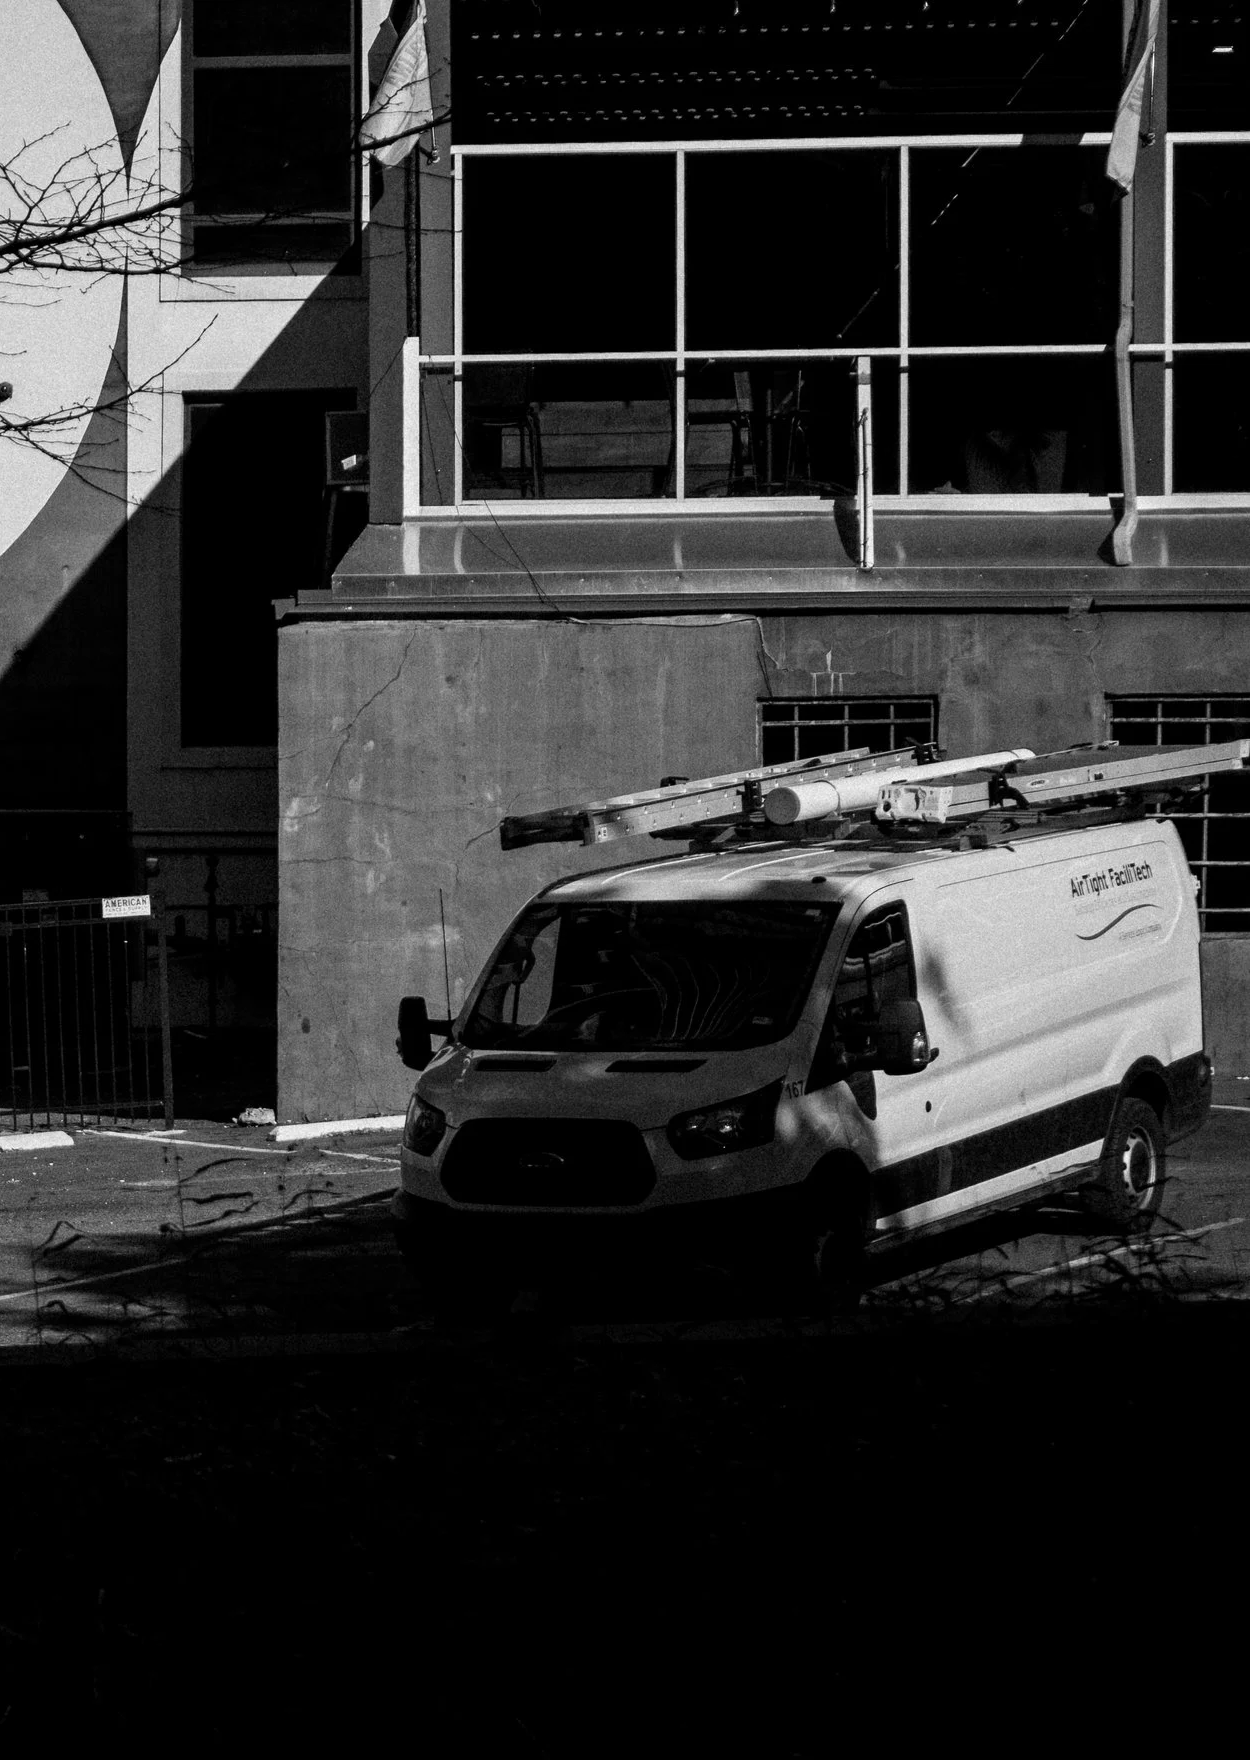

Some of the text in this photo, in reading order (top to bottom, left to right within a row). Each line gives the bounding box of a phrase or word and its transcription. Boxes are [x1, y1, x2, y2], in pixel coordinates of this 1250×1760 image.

[1070, 860, 1153, 898] AirTight FaciliTech
[105, 898, 147, 907] AMERICAN
